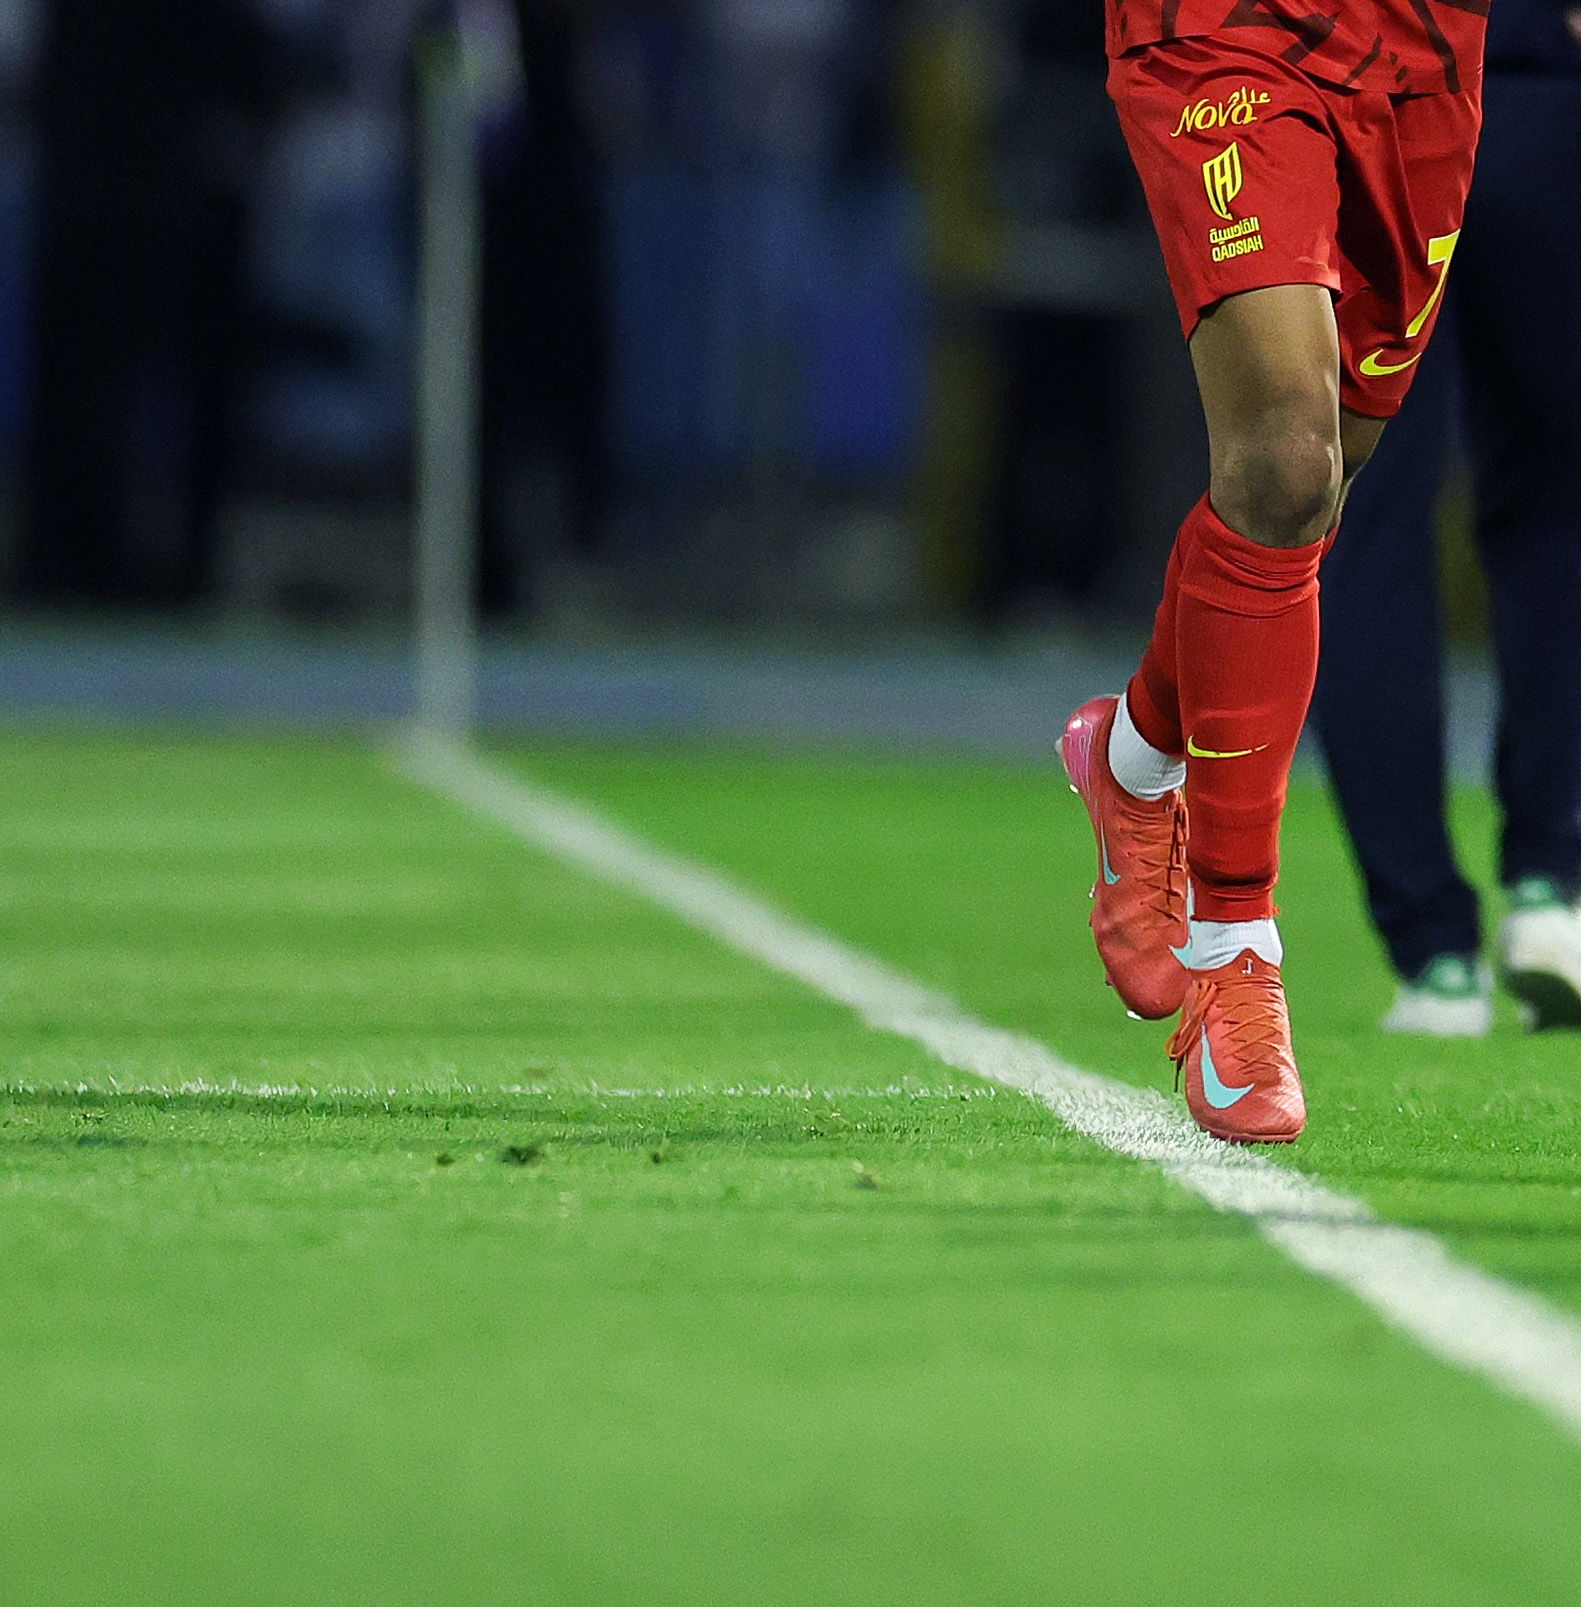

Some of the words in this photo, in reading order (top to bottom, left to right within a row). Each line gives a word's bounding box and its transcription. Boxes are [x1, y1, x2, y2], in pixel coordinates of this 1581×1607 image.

[1209, 216, 1260, 245] القادسية
[1211, 234, 1264, 262] QADSIAH
[1404, 228, 1461, 338] 7
